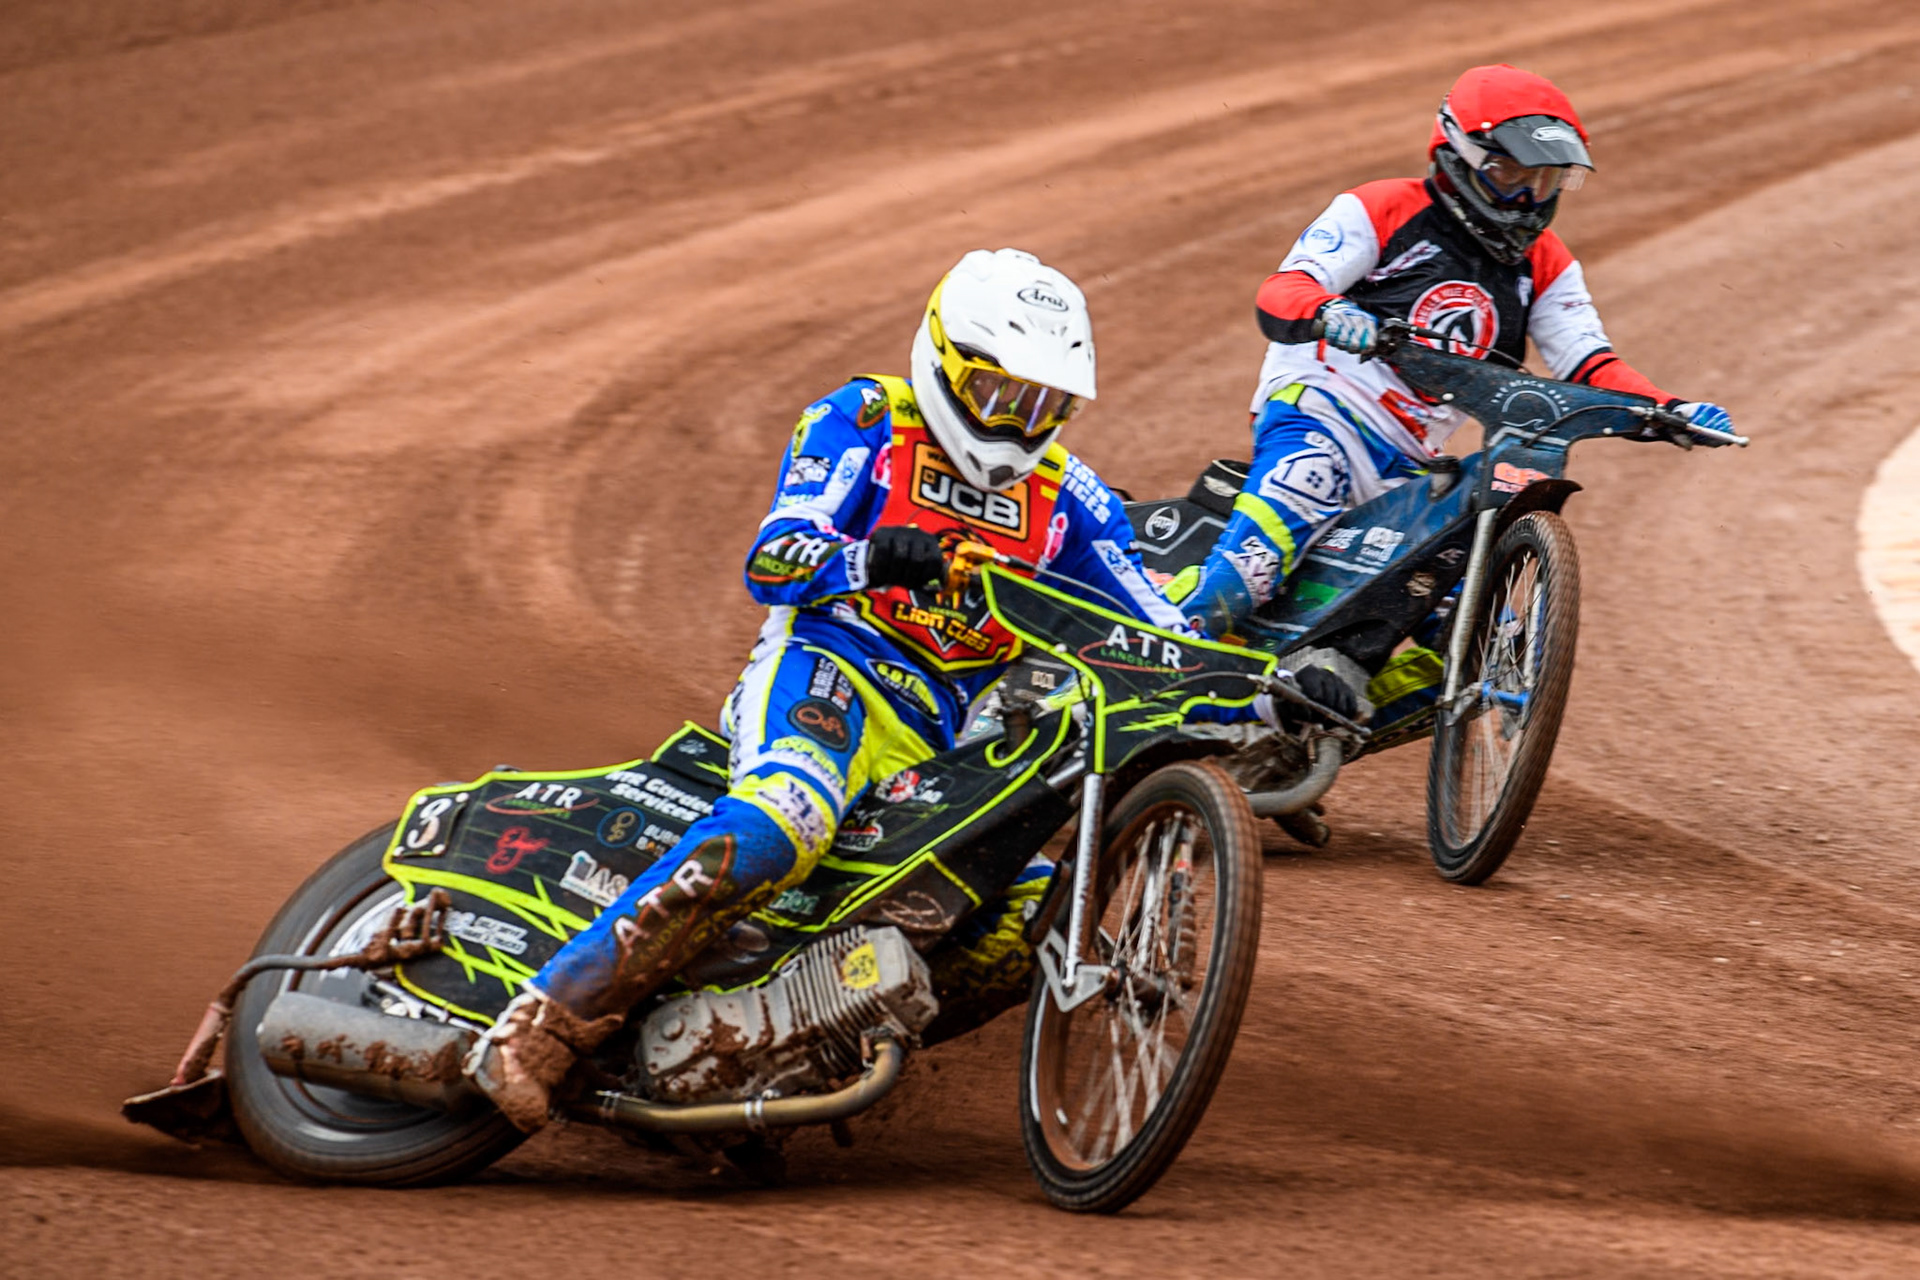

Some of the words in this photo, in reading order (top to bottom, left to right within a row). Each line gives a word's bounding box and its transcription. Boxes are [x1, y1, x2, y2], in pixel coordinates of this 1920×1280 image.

[1021, 288, 1066, 309] Arai
[921, 475, 1020, 528] JCB
[1106, 624, 1182, 670] ATR
[515, 781, 583, 810] ATR
[609, 782, 701, 822] Services
[407, 797, 452, 849] 3
[614, 859, 715, 955] ATR
